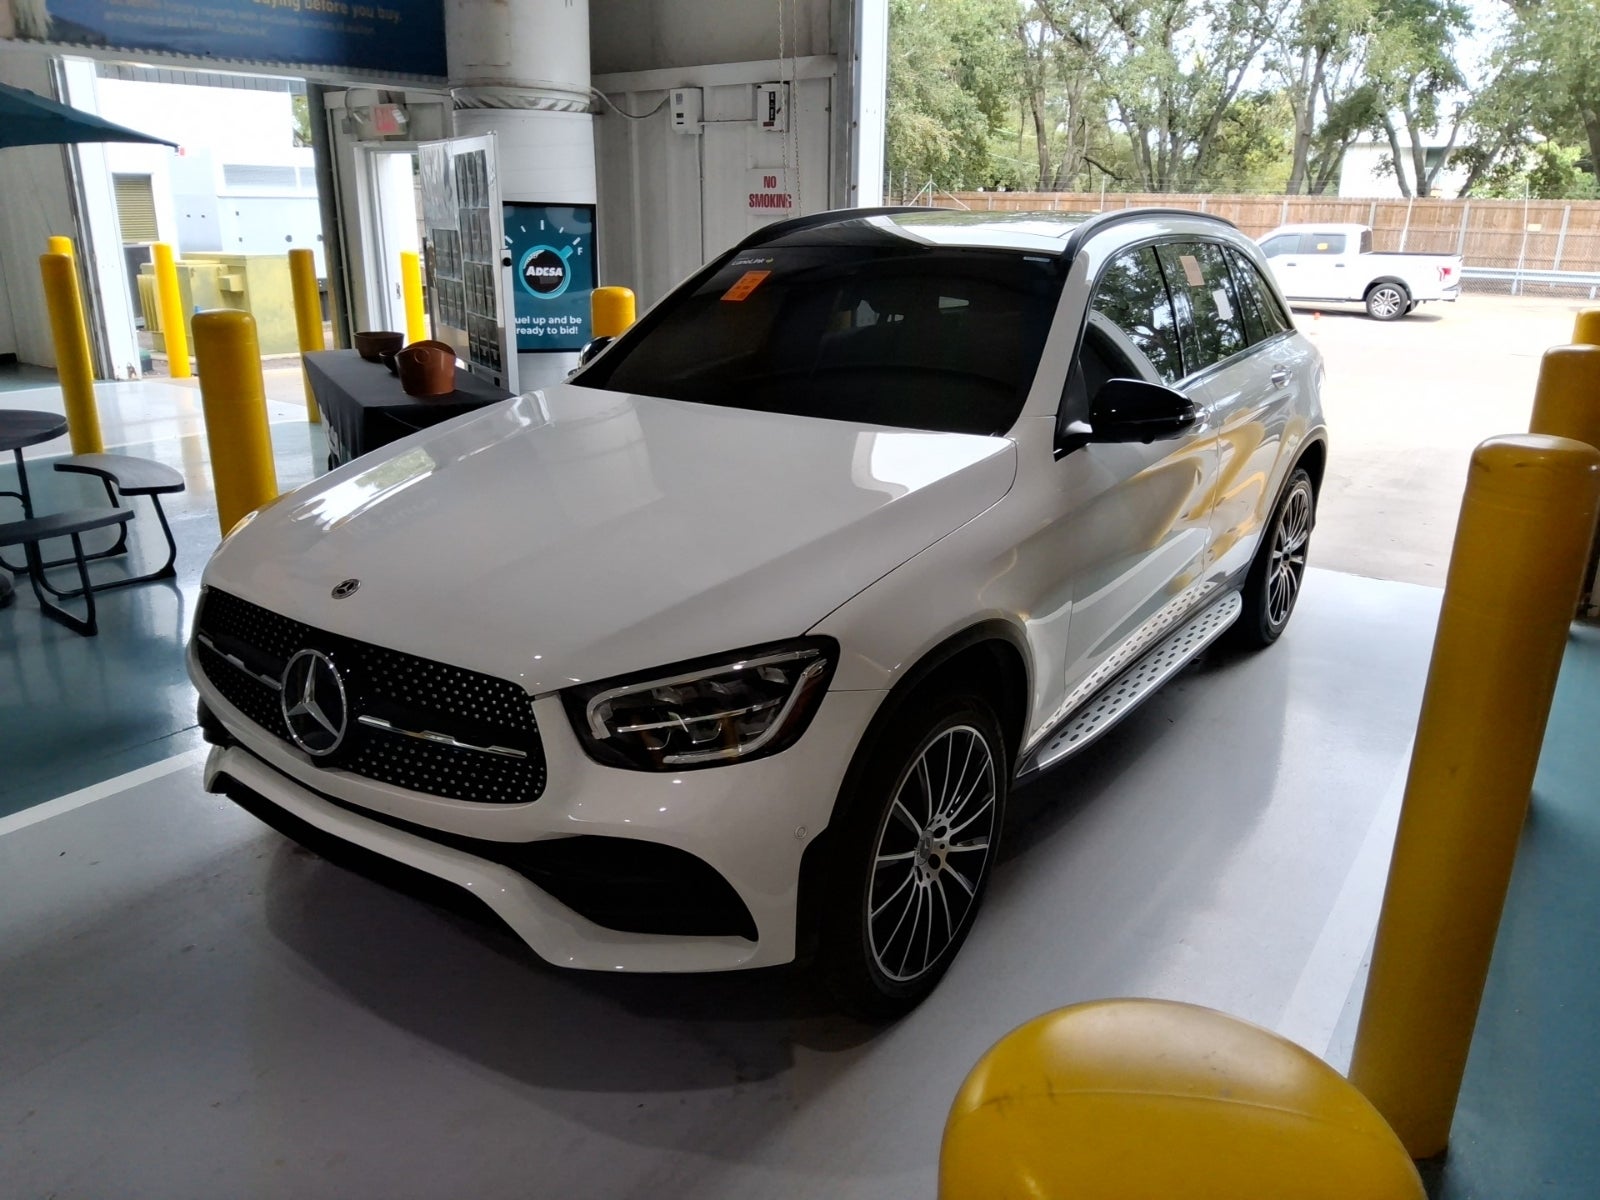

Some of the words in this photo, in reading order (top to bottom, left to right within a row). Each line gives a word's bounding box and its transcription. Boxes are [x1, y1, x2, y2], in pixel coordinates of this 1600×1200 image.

[253, 0, 300, 12] ying
[352, 4, 374, 19] you
[763, 175, 777, 189] NO
[749, 193, 792, 208] SMOKING
[577, 247, 583, 256] F
[526, 266, 563, 276] ADESA
[514, 315, 530, 324] uel
[532, 316, 546, 326] up
[548, 315, 568, 324] and
[569, 315, 582, 324] be
[516, 326, 545, 337] ready
[546, 326, 558, 335] to
[559, 325, 579, 335] bid!
